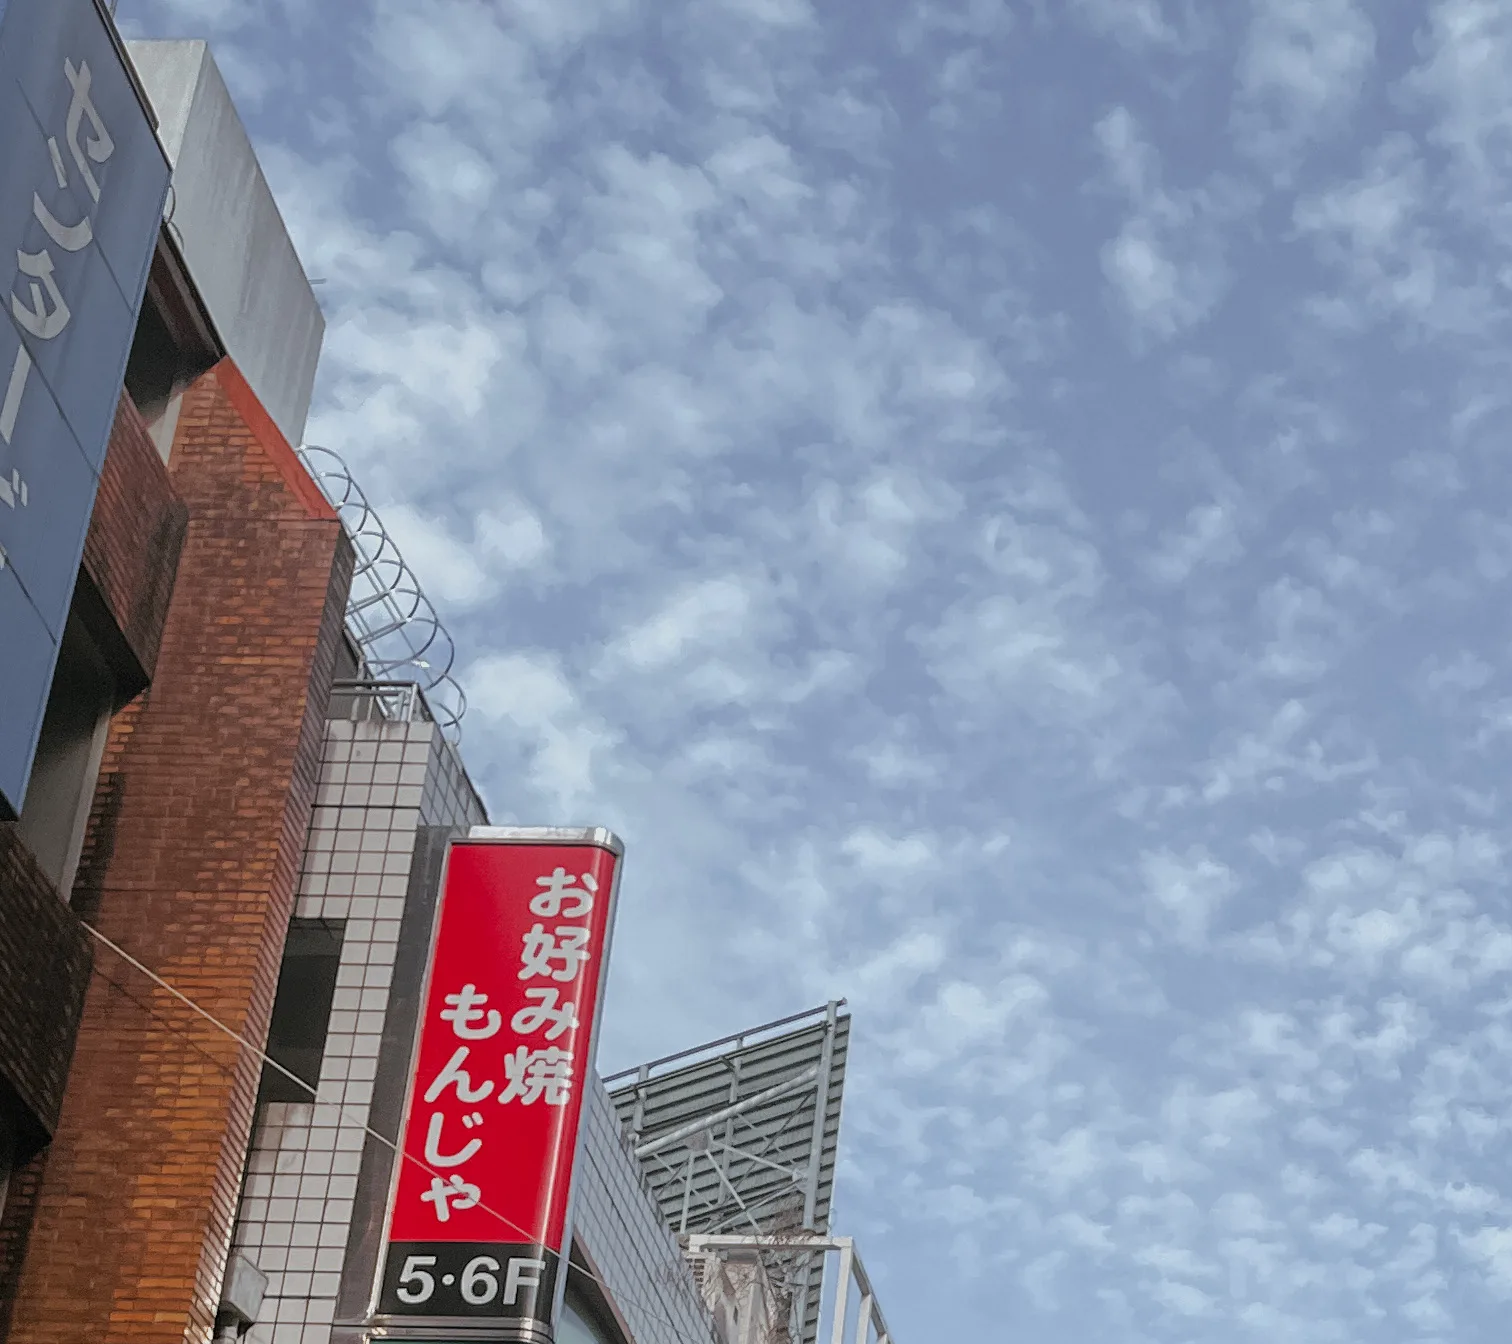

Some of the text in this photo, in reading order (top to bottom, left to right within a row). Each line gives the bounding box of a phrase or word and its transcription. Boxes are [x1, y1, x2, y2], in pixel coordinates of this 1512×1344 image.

[420, 983, 502, 1224] もんじゃ
[499, 867, 599, 1108] お好み焼
